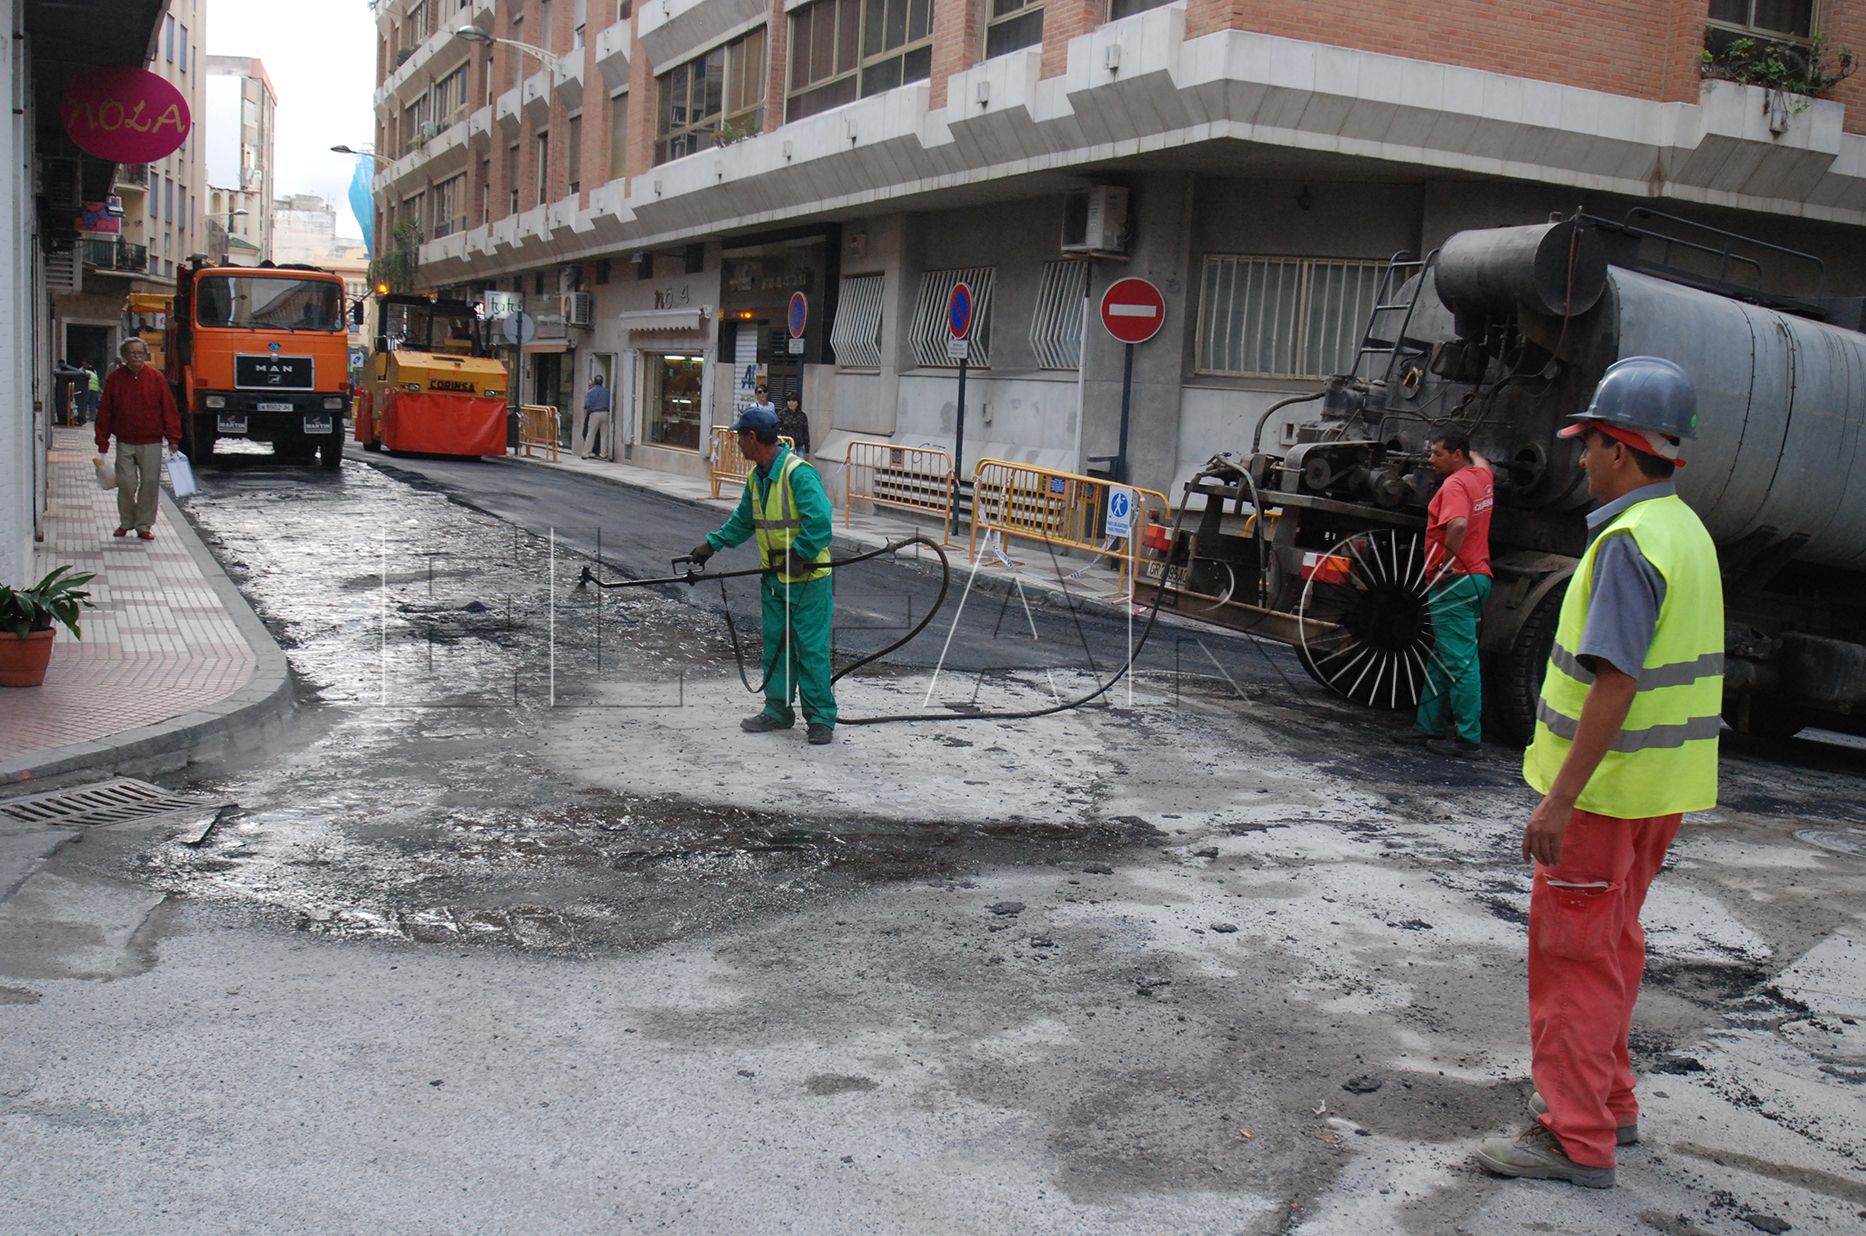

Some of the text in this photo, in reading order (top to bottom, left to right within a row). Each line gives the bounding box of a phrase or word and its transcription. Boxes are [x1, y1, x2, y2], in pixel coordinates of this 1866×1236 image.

[67, 99, 186, 133] NOLA
[256, 364, 293, 373] MAN
[430, 379, 476, 393] CORINSA
